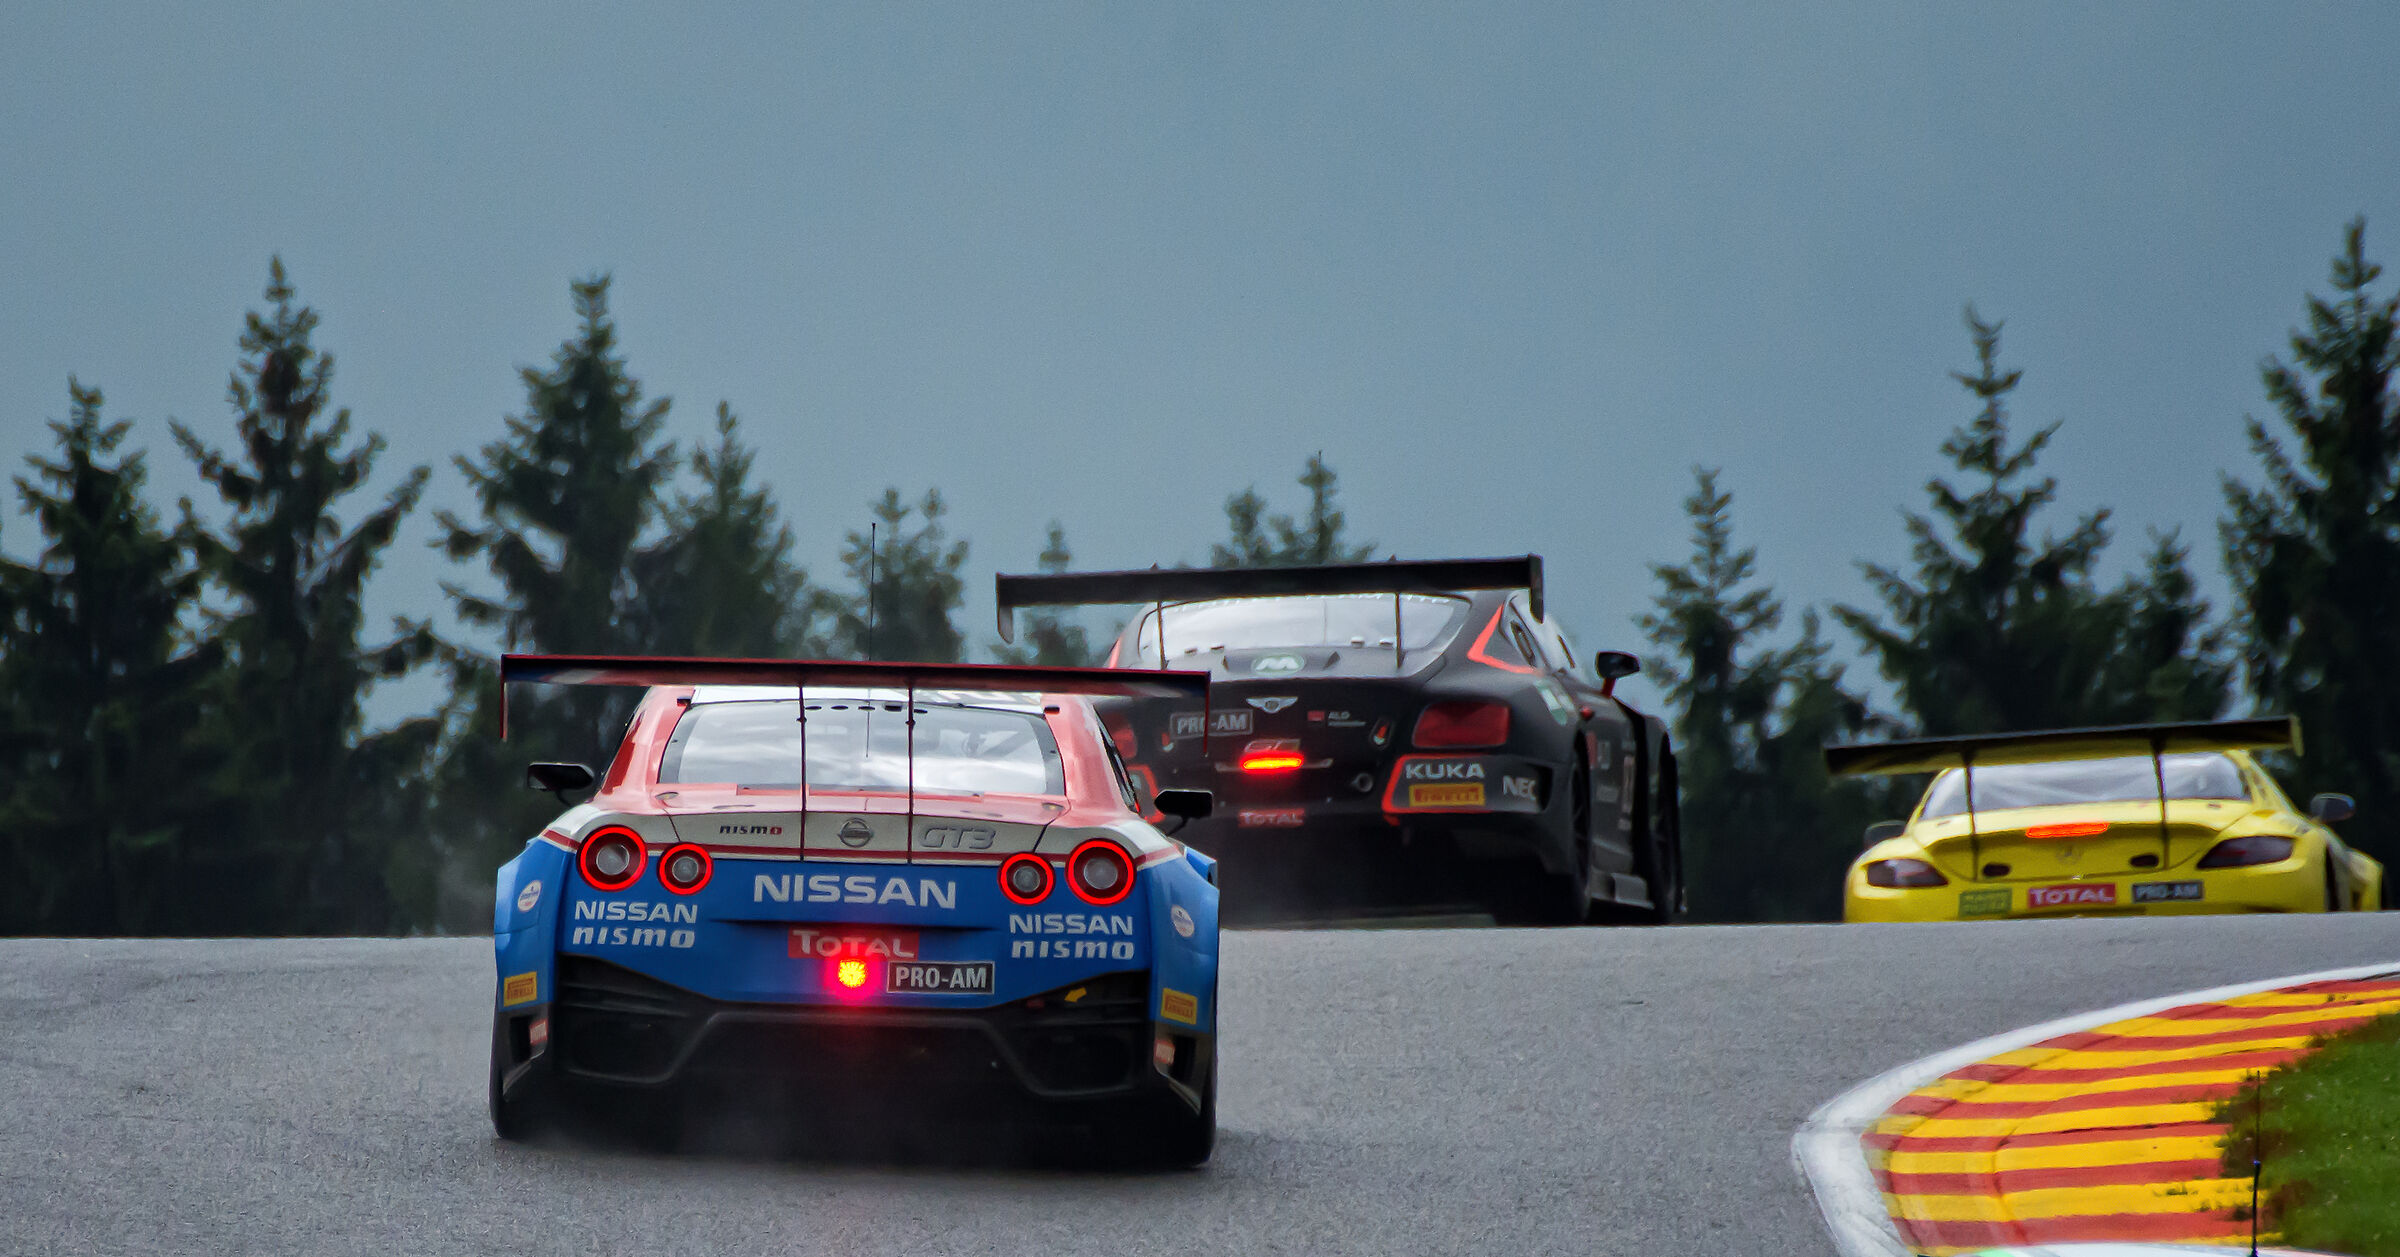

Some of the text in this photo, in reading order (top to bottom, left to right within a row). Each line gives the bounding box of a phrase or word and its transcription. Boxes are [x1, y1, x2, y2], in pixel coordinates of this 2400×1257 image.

[1405, 763, 1485, 779] KUKA
[1240, 812, 1302, 824] TOTAL
[719, 825, 783, 835] nismo
[920, 826, 996, 849] GT3
[753, 874, 957, 909] NISSAN
[2030, 887, 2116, 905] TOTAL
[575, 901, 698, 924] NISSAN
[1008, 914, 1133, 936] NISSAN
[572, 927, 696, 949] nismo
[793, 930, 914, 957] TOTAL
[1011, 940, 1135, 960] nismo
[895, 967, 987, 988] PRO-AM
